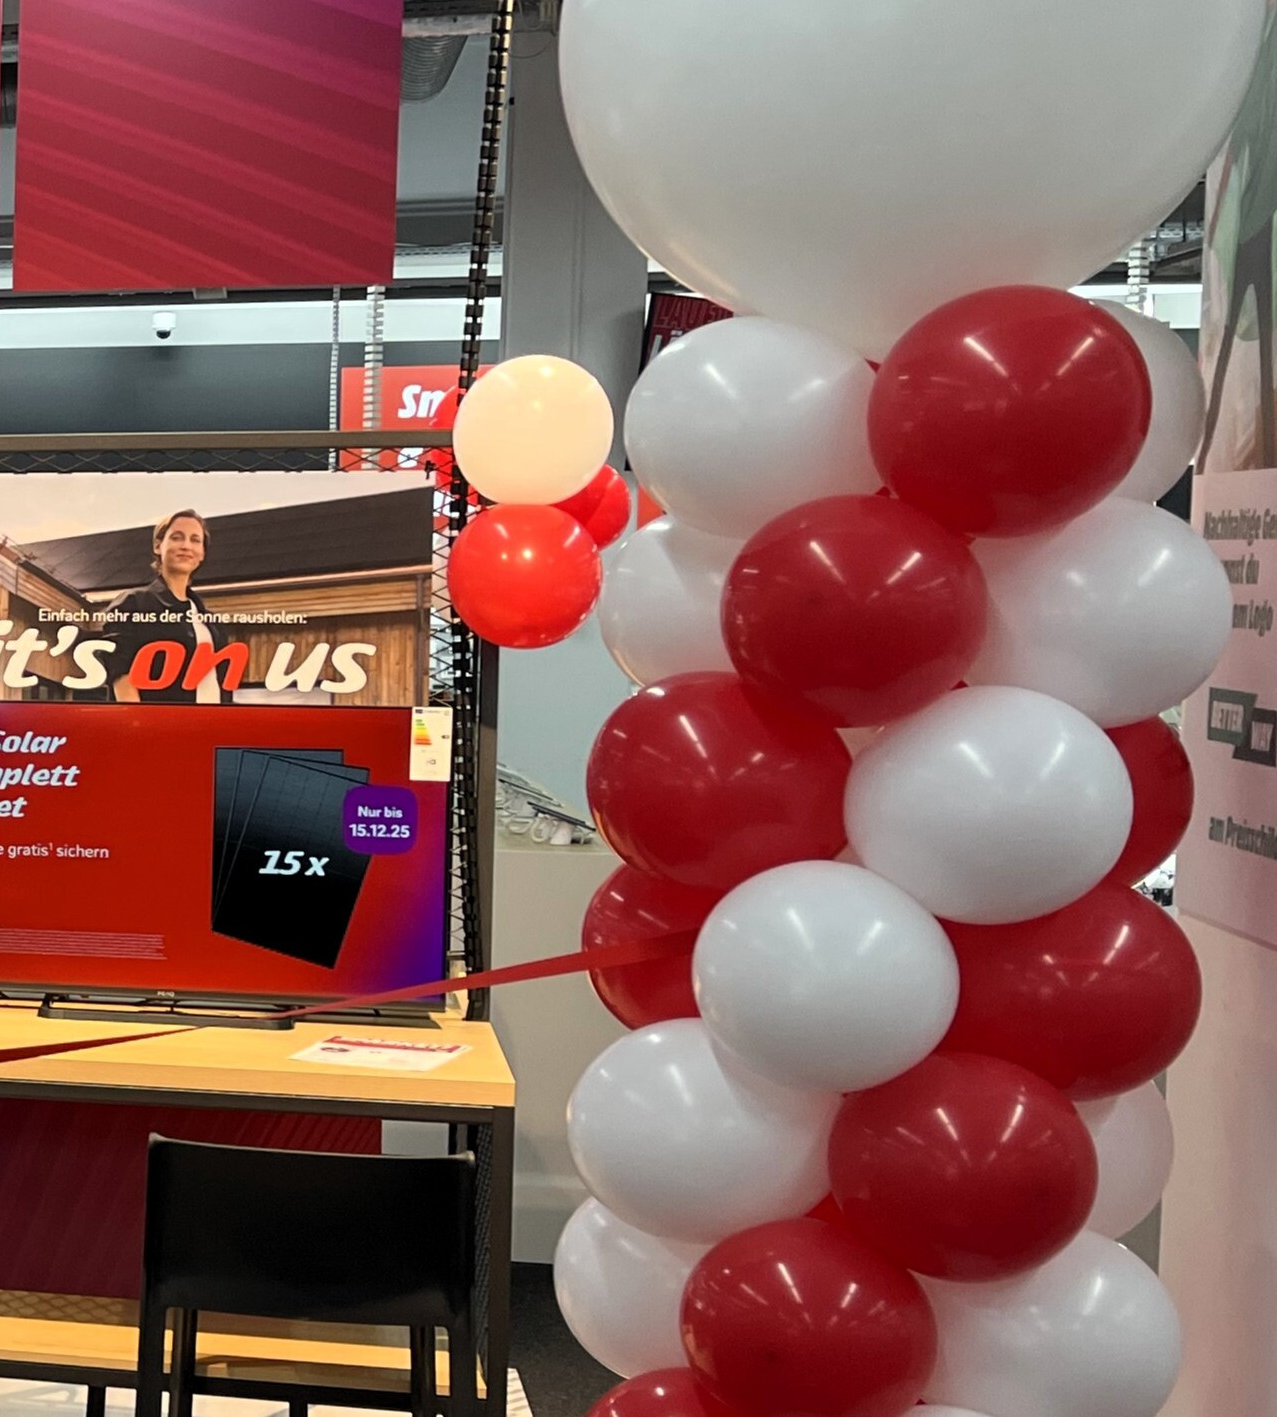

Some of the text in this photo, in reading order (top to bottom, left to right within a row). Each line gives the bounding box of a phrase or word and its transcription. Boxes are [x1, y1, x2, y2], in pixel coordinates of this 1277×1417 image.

[39, 608, 308, 625] Einfach mehr aus der Sonne rausholen:
[128, 641, 250, 691] on
[265, 642, 378, 694] us
[357, 806, 403, 819] Nur bis
[349, 823, 411, 839] 15.12.25
[56, 844, 110, 859] sichern
[258, 850, 330, 876] 15 x
